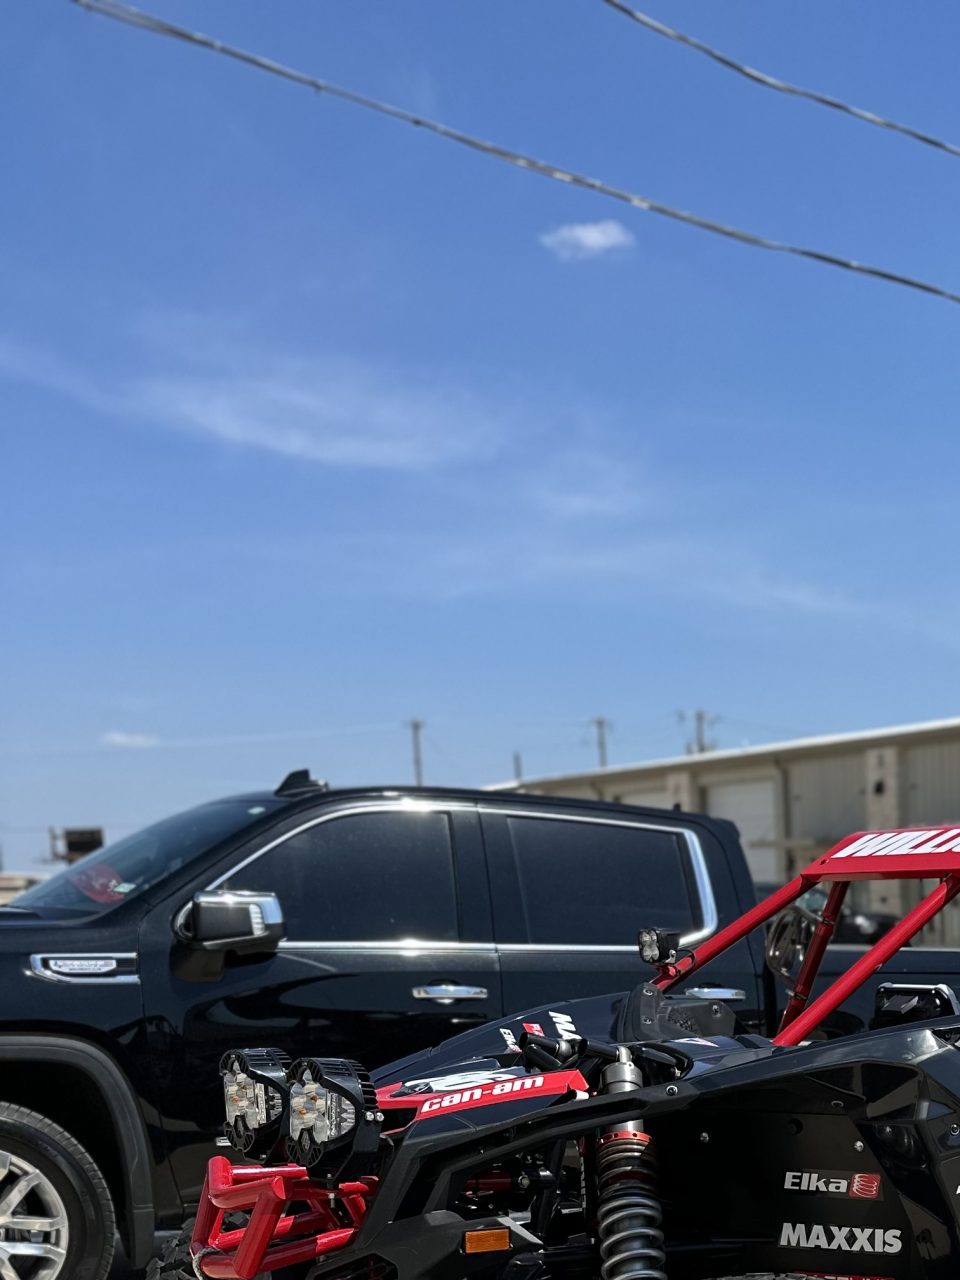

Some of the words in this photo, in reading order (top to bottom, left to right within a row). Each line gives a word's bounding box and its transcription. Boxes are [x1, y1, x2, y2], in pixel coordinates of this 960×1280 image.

[420, 1075, 545, 1113] can-am
[783, 1171, 848, 1193] Elka
[780, 1222, 903, 1254] MAXXIS
